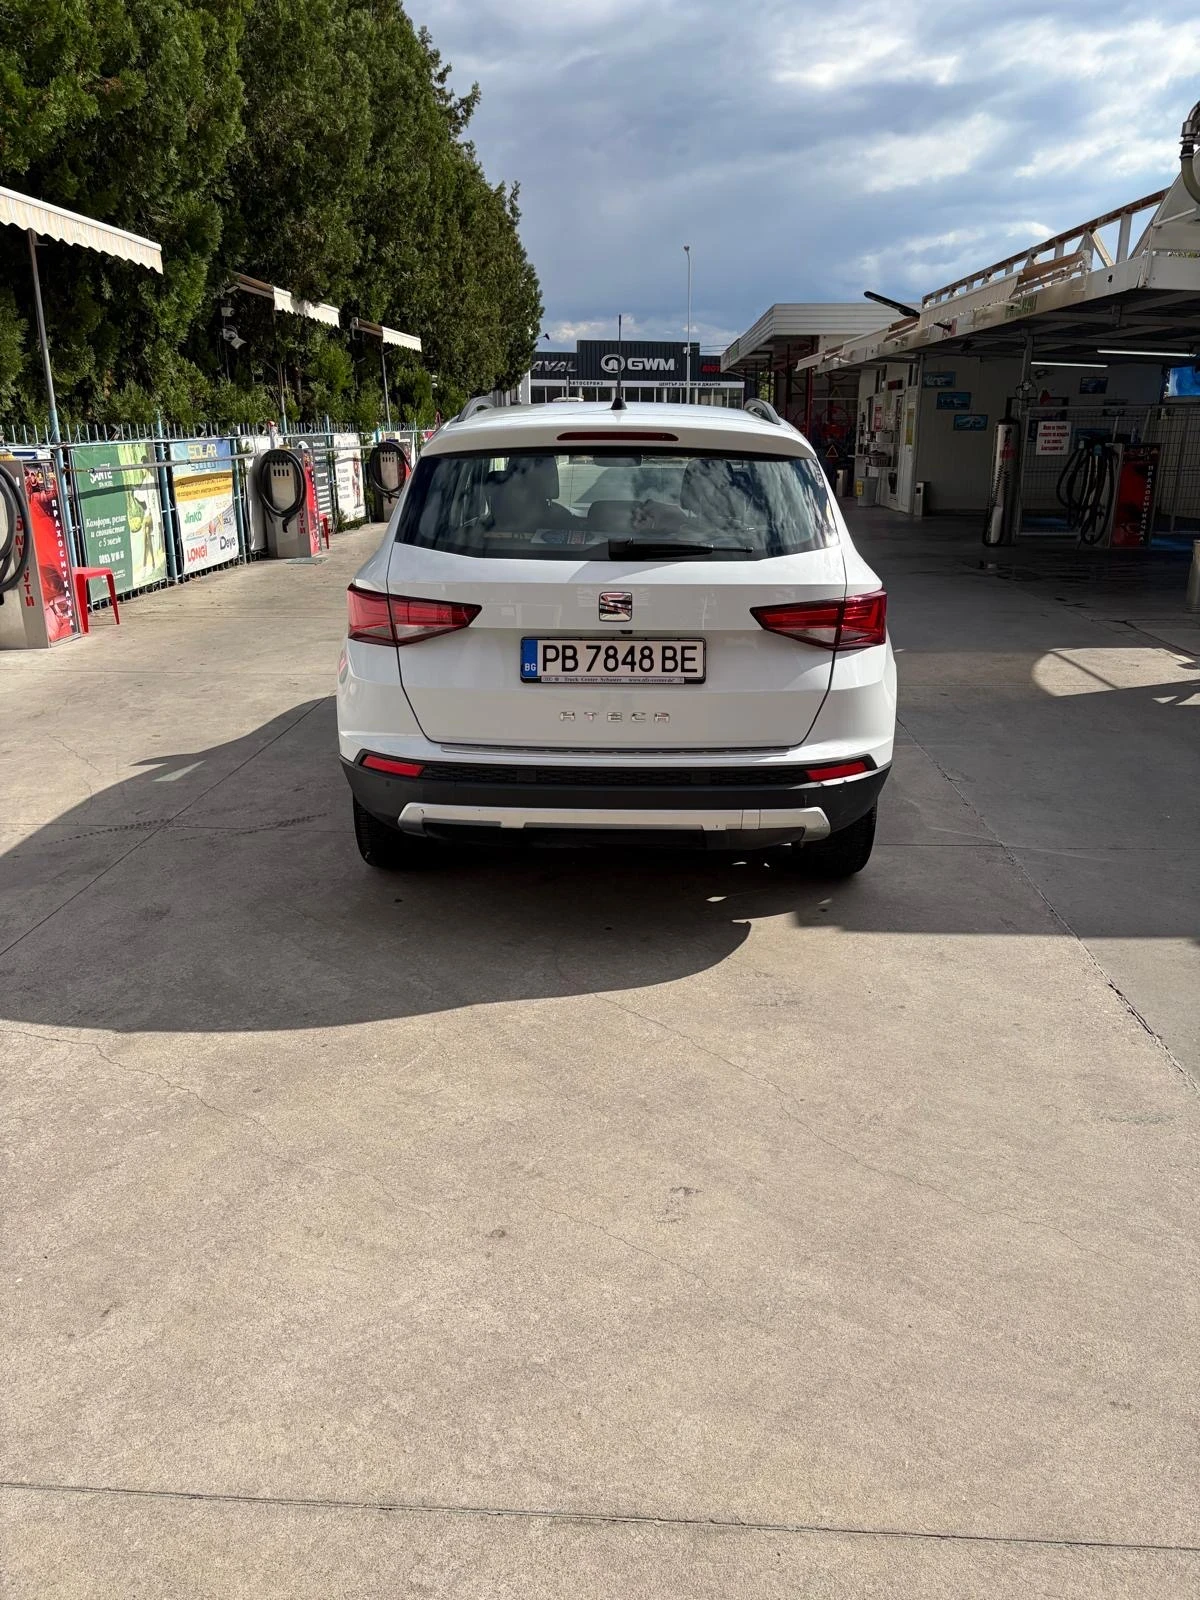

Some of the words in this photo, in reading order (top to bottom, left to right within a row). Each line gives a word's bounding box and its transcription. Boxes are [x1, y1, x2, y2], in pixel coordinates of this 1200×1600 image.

[531, 360, 578, 372] AVAL
[627, 357, 675, 371] GWM
[187, 443, 218, 460] SOLAR
[1138, 464, 1154, 543] ПРАХОСМУКАЧКА
[219, 536, 236, 550] Deye
[51, 499, 74, 627] ПРАХОСМУКАЧКА
[542, 644, 579, 673] PB
[585, 644, 655, 673] 7848
[661, 645, 698, 673] BE
[524, 663, 537, 672] BG
[558, 711, 671, 723] ATECA
